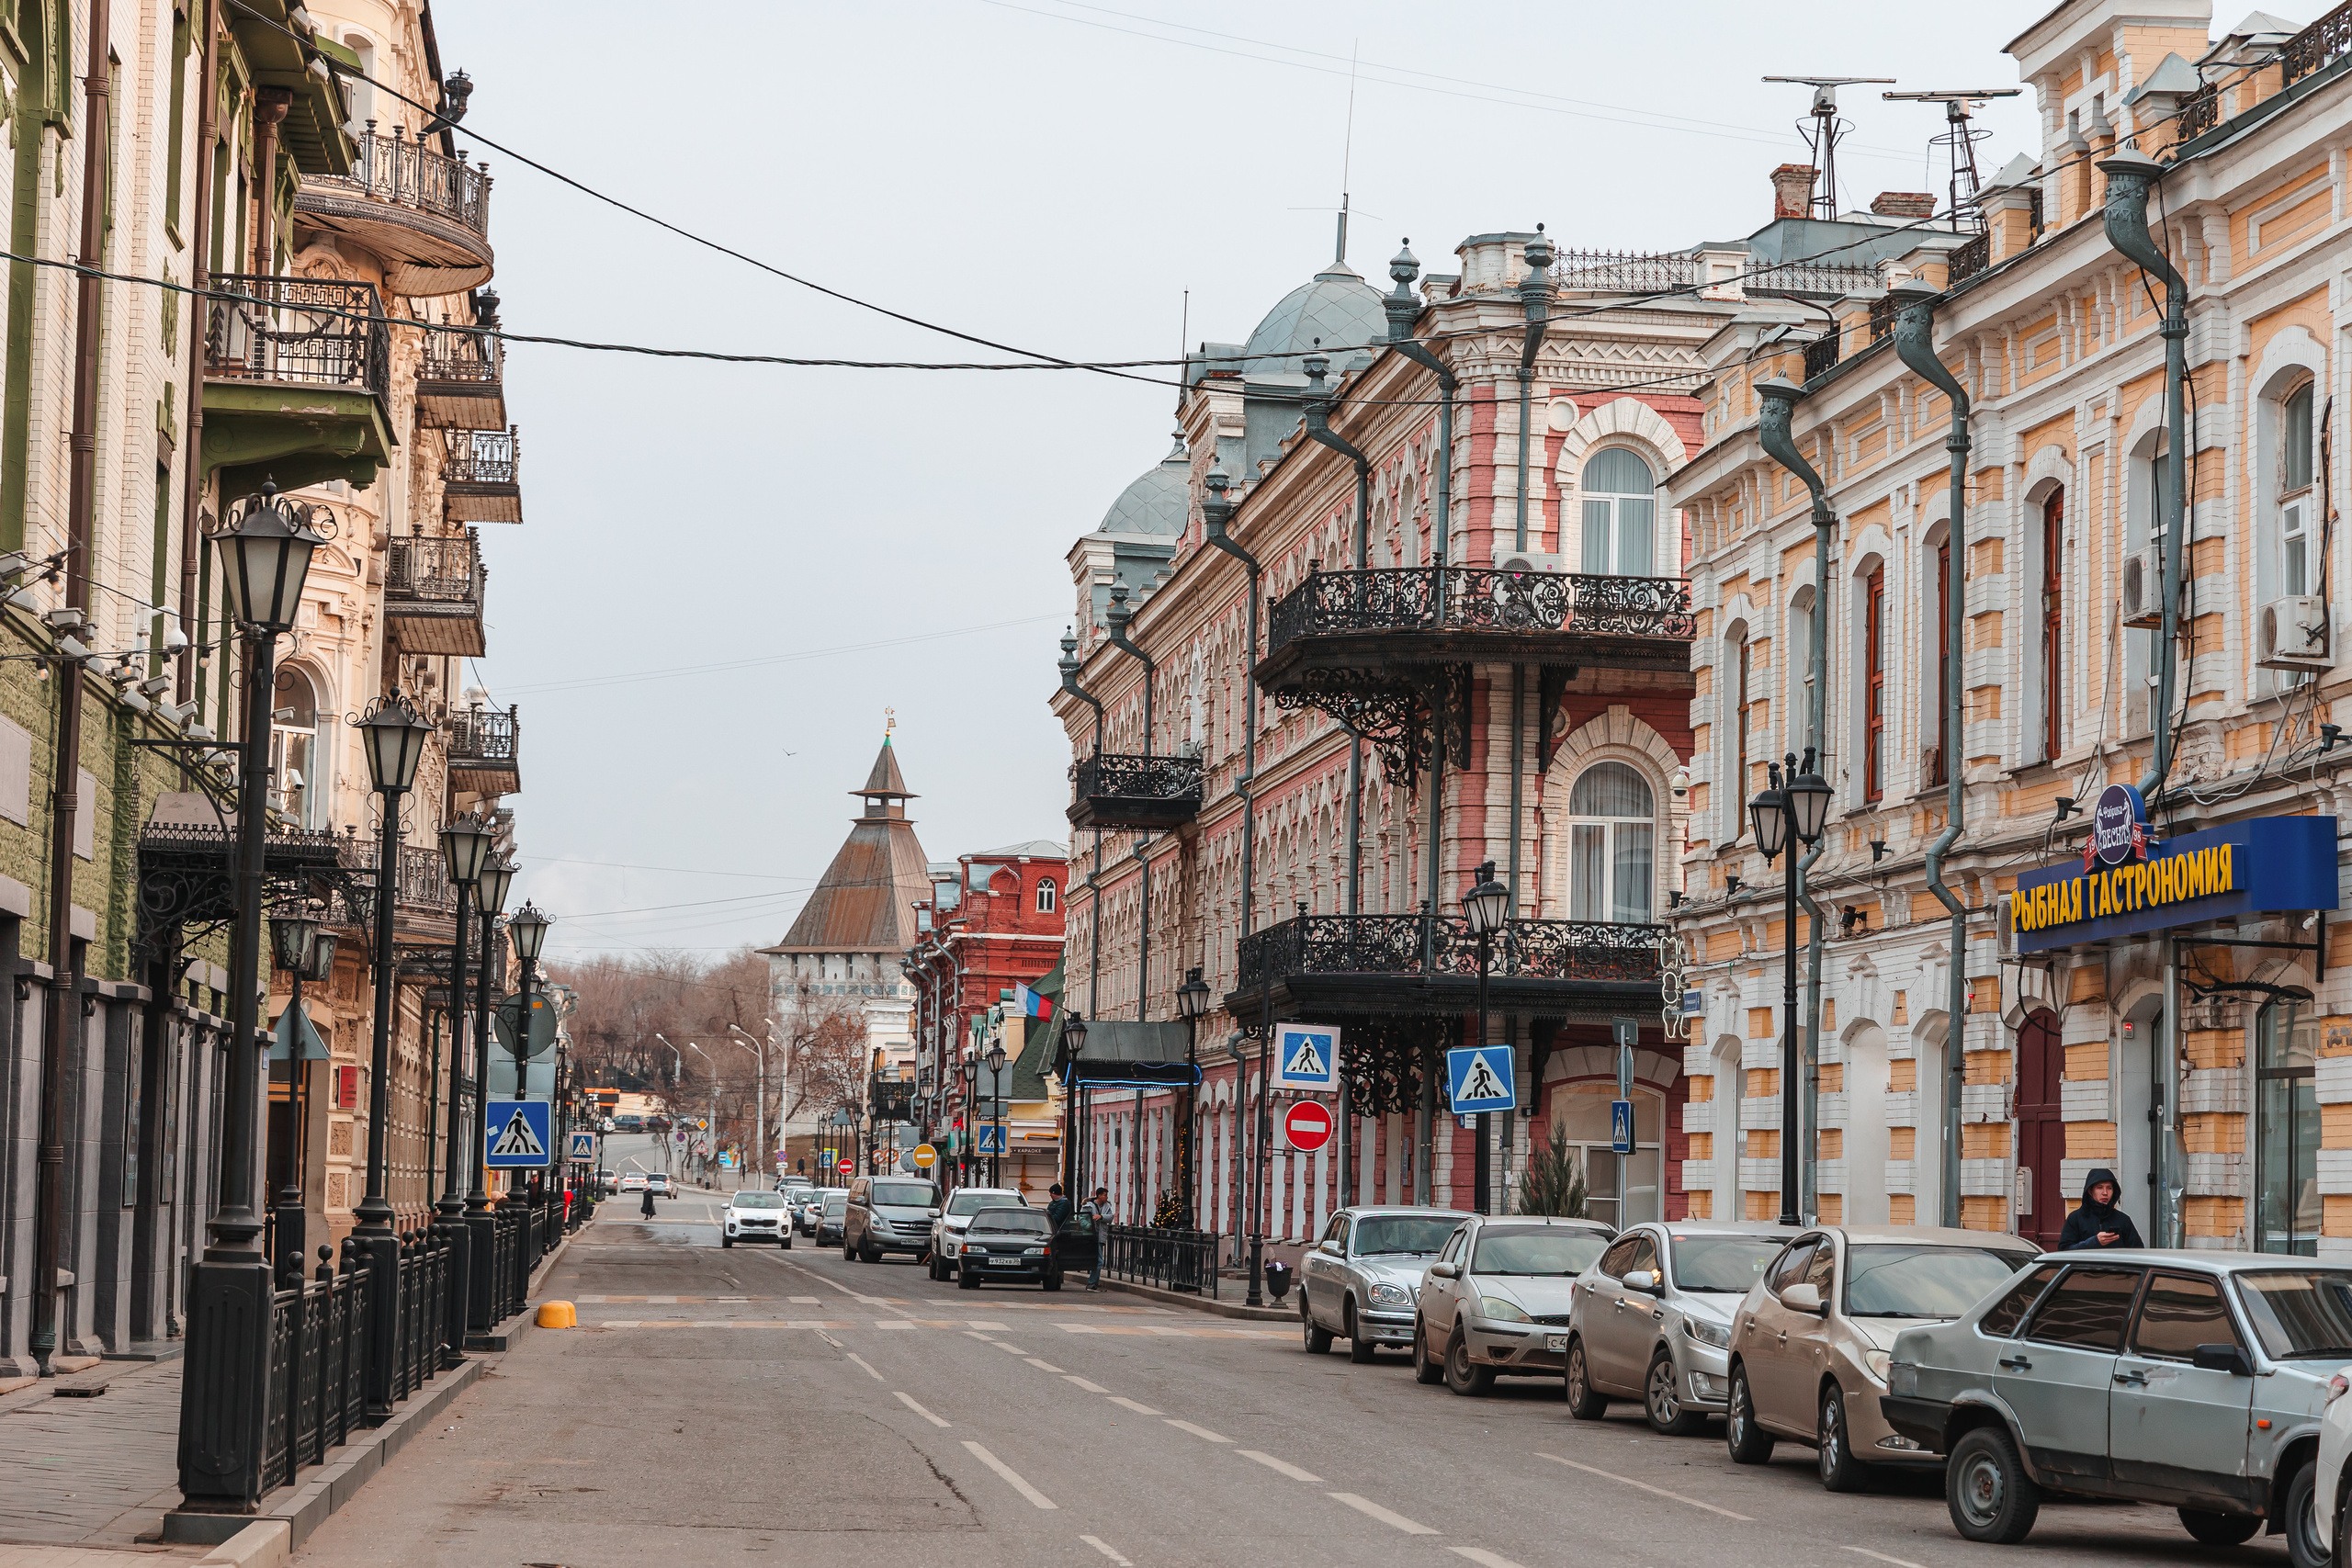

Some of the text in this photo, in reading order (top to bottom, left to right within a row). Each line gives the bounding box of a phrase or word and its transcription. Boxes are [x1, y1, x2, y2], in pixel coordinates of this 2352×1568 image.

[2133, 830, 2142, 842] 98
[2011, 843, 2233, 933] РЫБНАЯ ГАСТРОНОМИЯ
